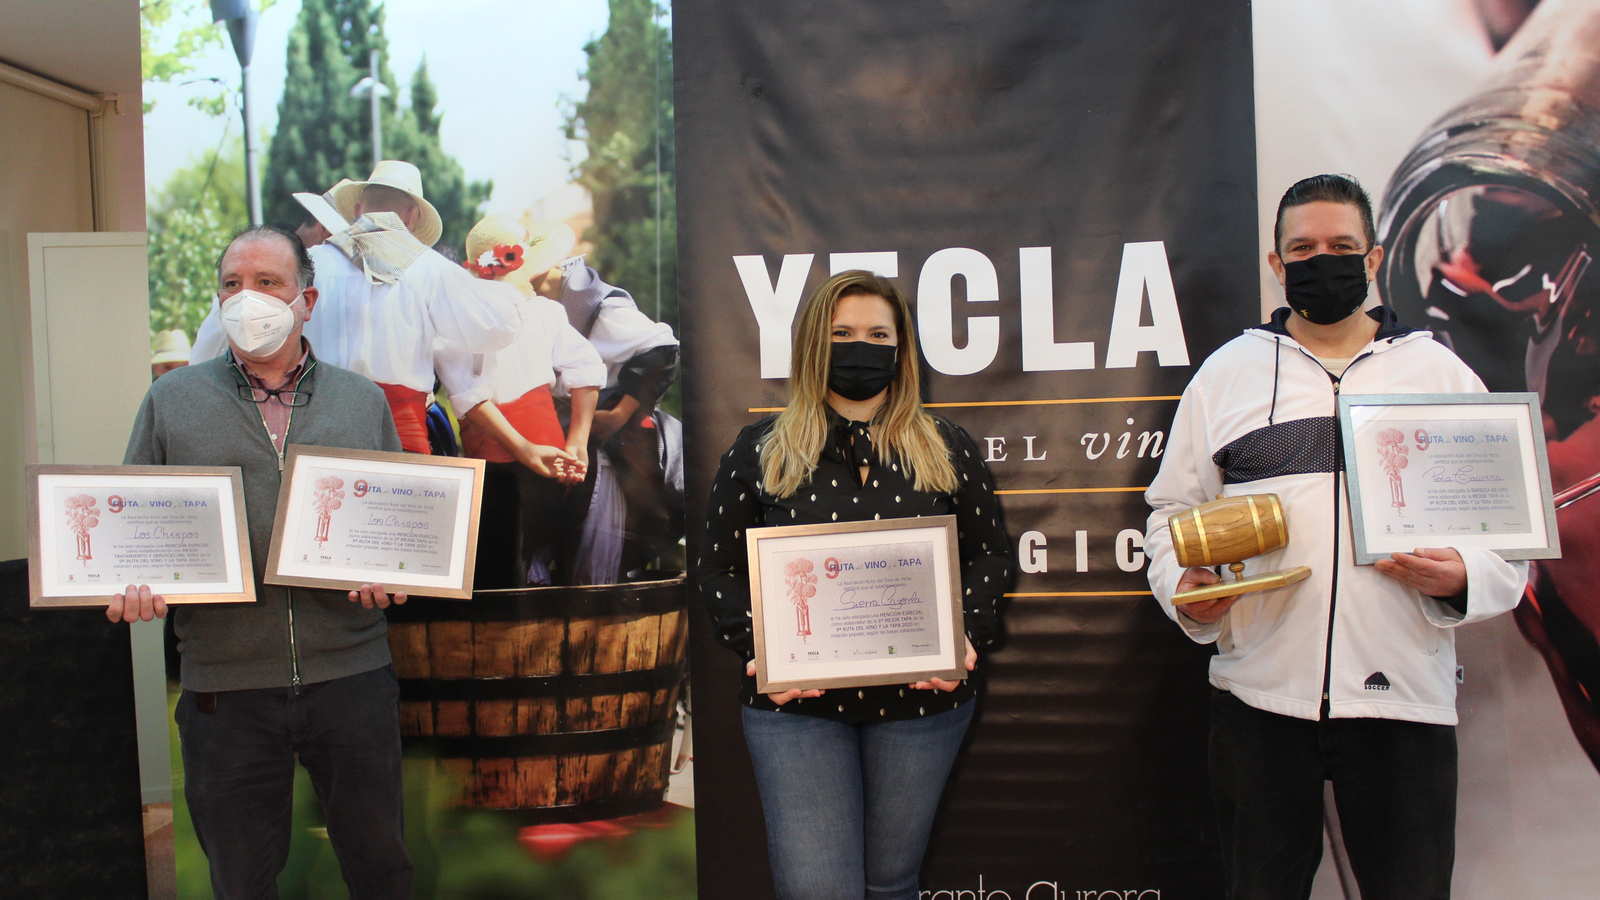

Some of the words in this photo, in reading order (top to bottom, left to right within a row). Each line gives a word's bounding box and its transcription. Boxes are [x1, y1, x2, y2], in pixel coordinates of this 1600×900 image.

[732, 240, 1191, 379] YCLA
[984, 436, 1047, 462] EL
[1080, 417, 1164, 460] vin
[148, 500, 172, 508] VINO
[183, 500, 208, 508] TAPA
[391, 487, 413, 496] VINO
[423, 489, 446, 499] TAPA
[864, 560, 887, 569] VINO
[898, 558, 922, 568] TAPA
[1018, 528, 1146, 574] GIC
